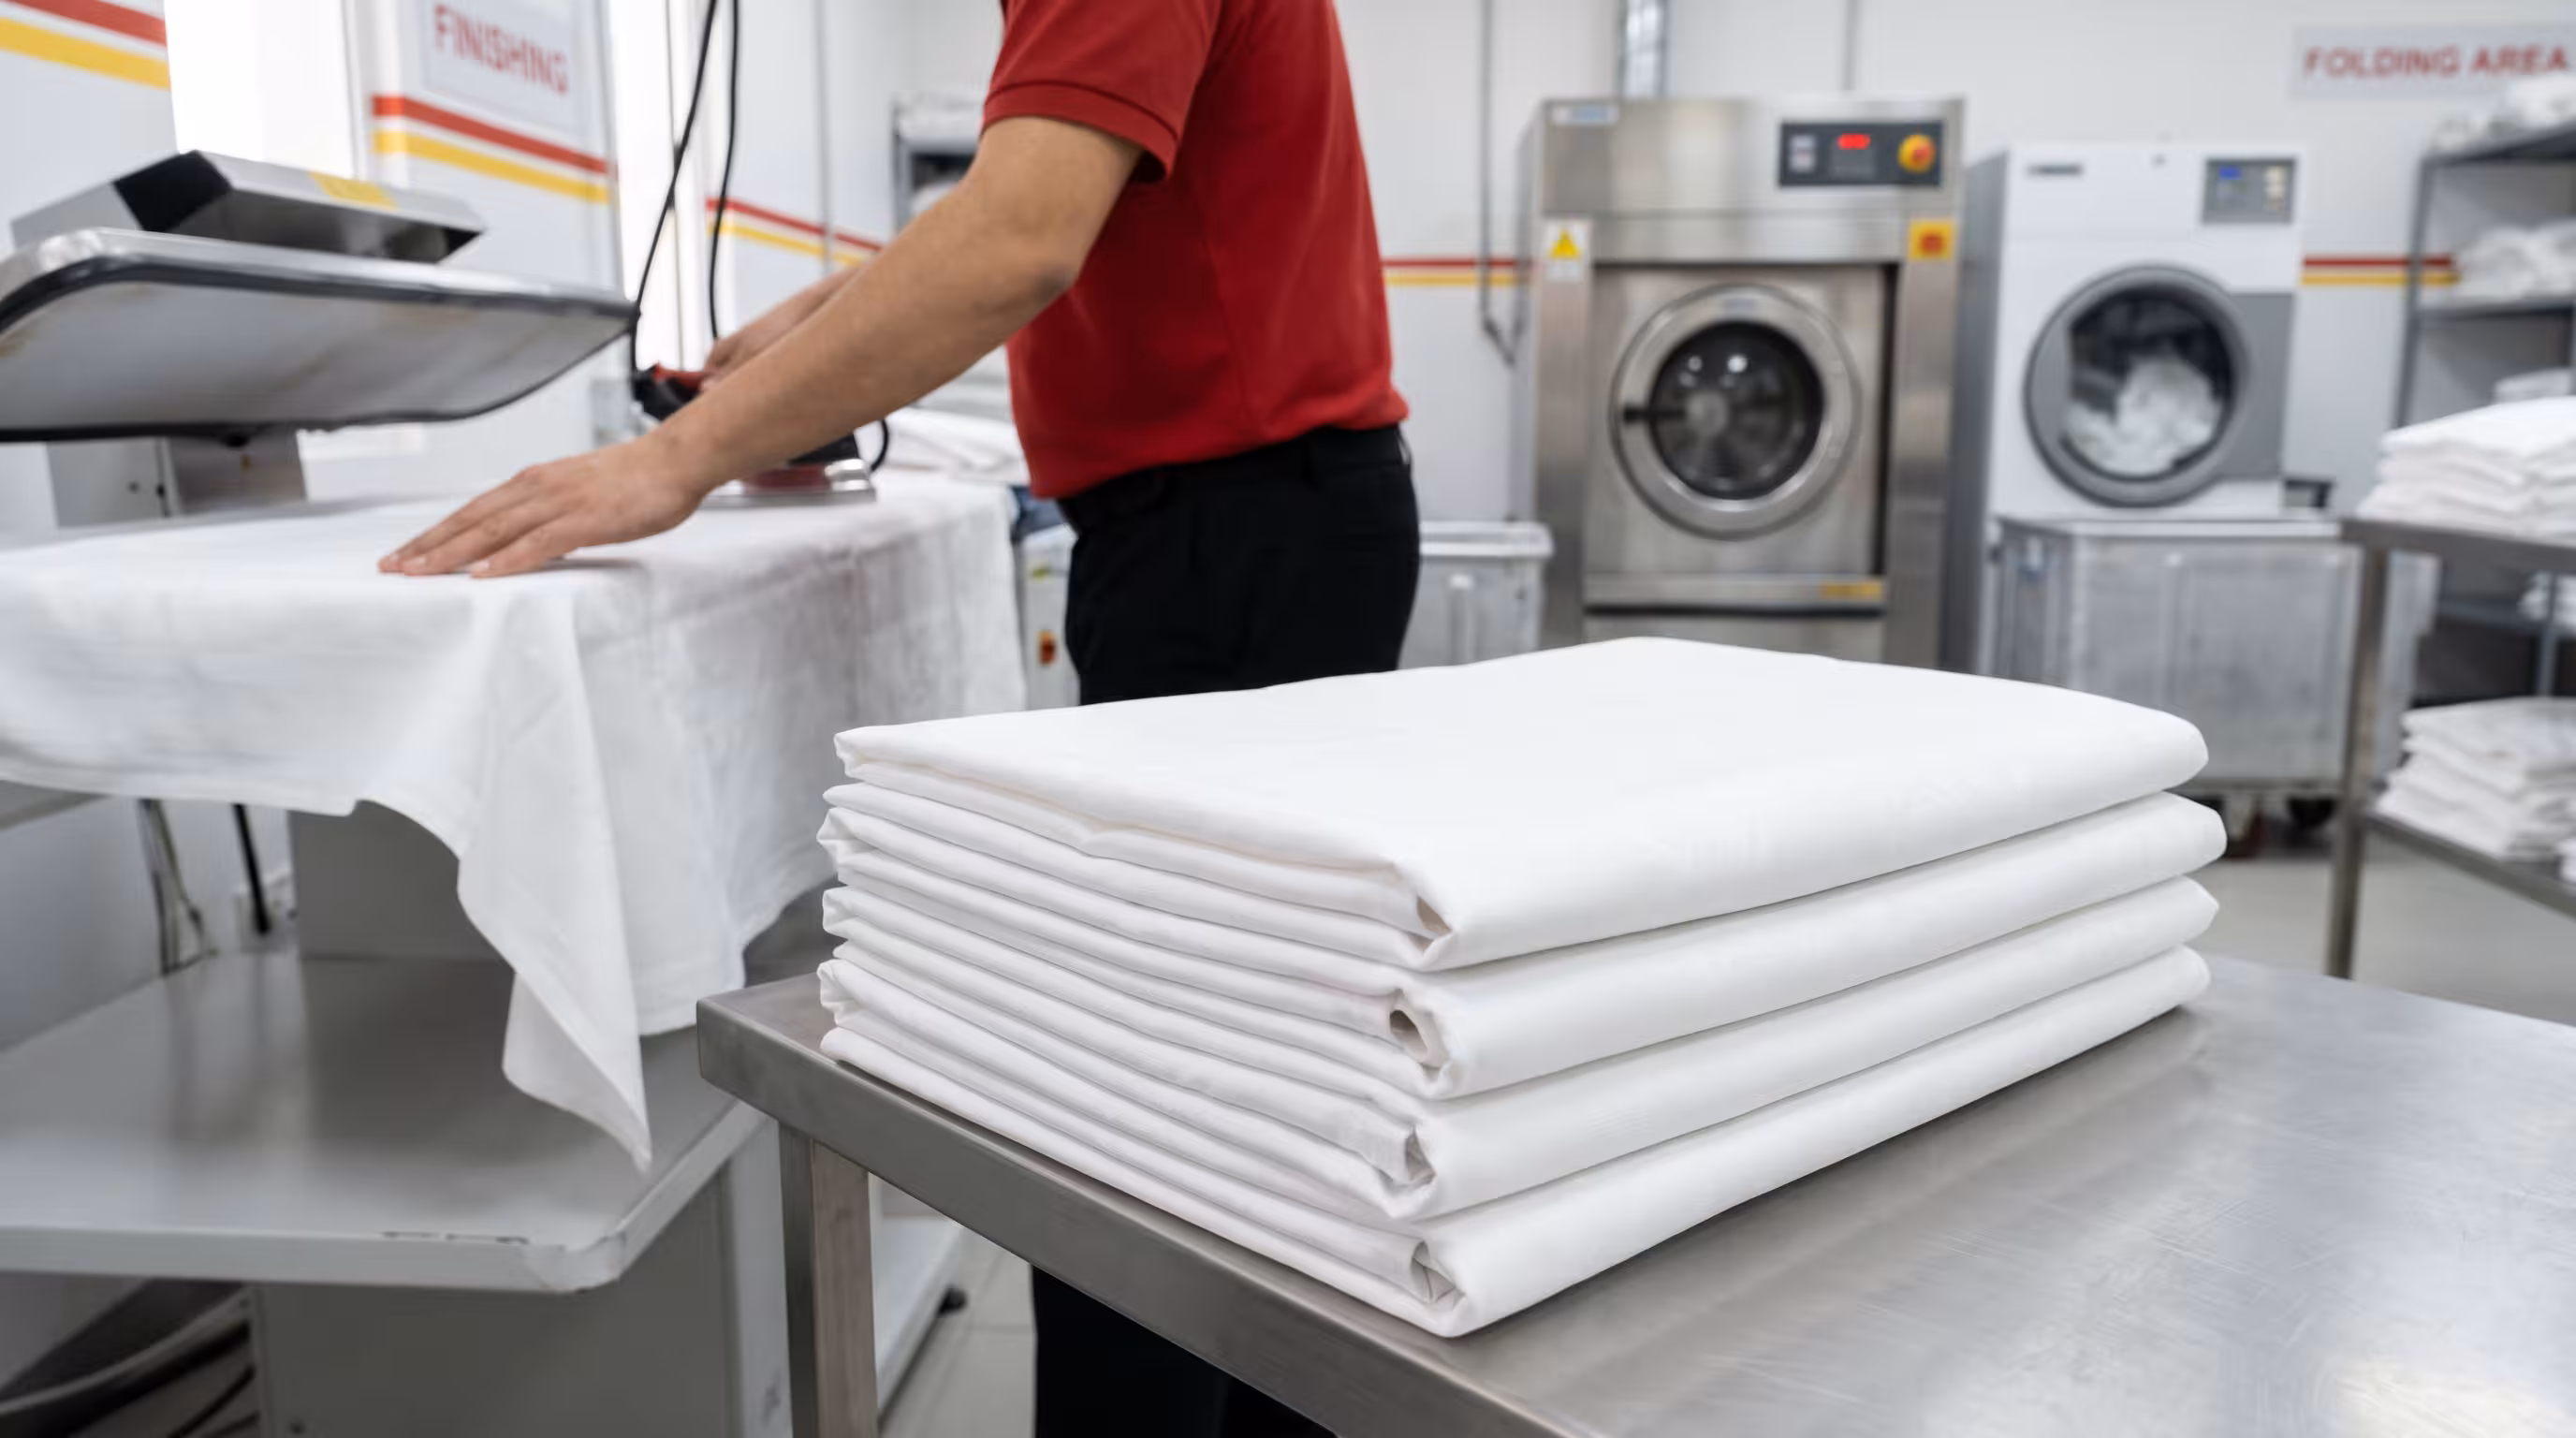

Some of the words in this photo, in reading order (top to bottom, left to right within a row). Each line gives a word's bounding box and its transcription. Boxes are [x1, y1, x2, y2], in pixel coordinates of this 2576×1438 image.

[433, 4, 570, 96] FINISHING
[2304, 46, 2462, 79] FOLDING
[2470, 43, 2569, 76] AREA
